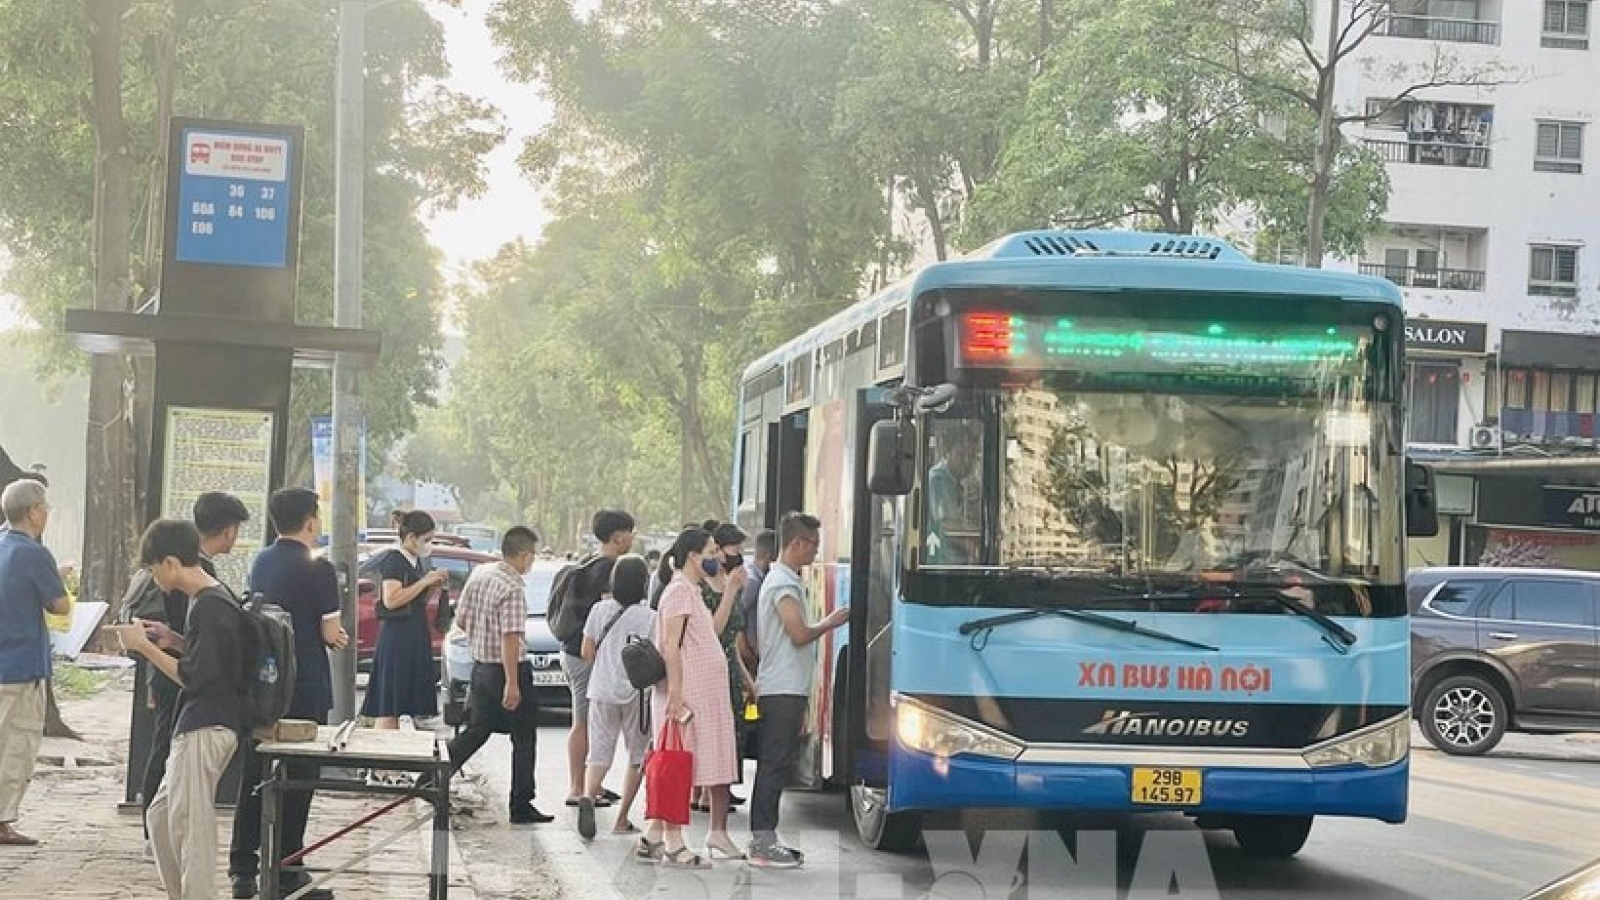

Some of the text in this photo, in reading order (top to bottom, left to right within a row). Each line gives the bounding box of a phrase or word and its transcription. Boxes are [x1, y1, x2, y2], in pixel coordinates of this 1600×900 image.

[261, 187, 275, 199] 37
[1404, 326, 1466, 344] SALON
[1123, 663, 1170, 688] BUS
[1178, 661, 1212, 690] HÀ
[1221, 663, 1271, 697] NỘI
[1081, 709, 1250, 737] HANOIBUS
[1152, 769, 1182, 785] 29B
[1141, 787, 1194, 802] 145.97
